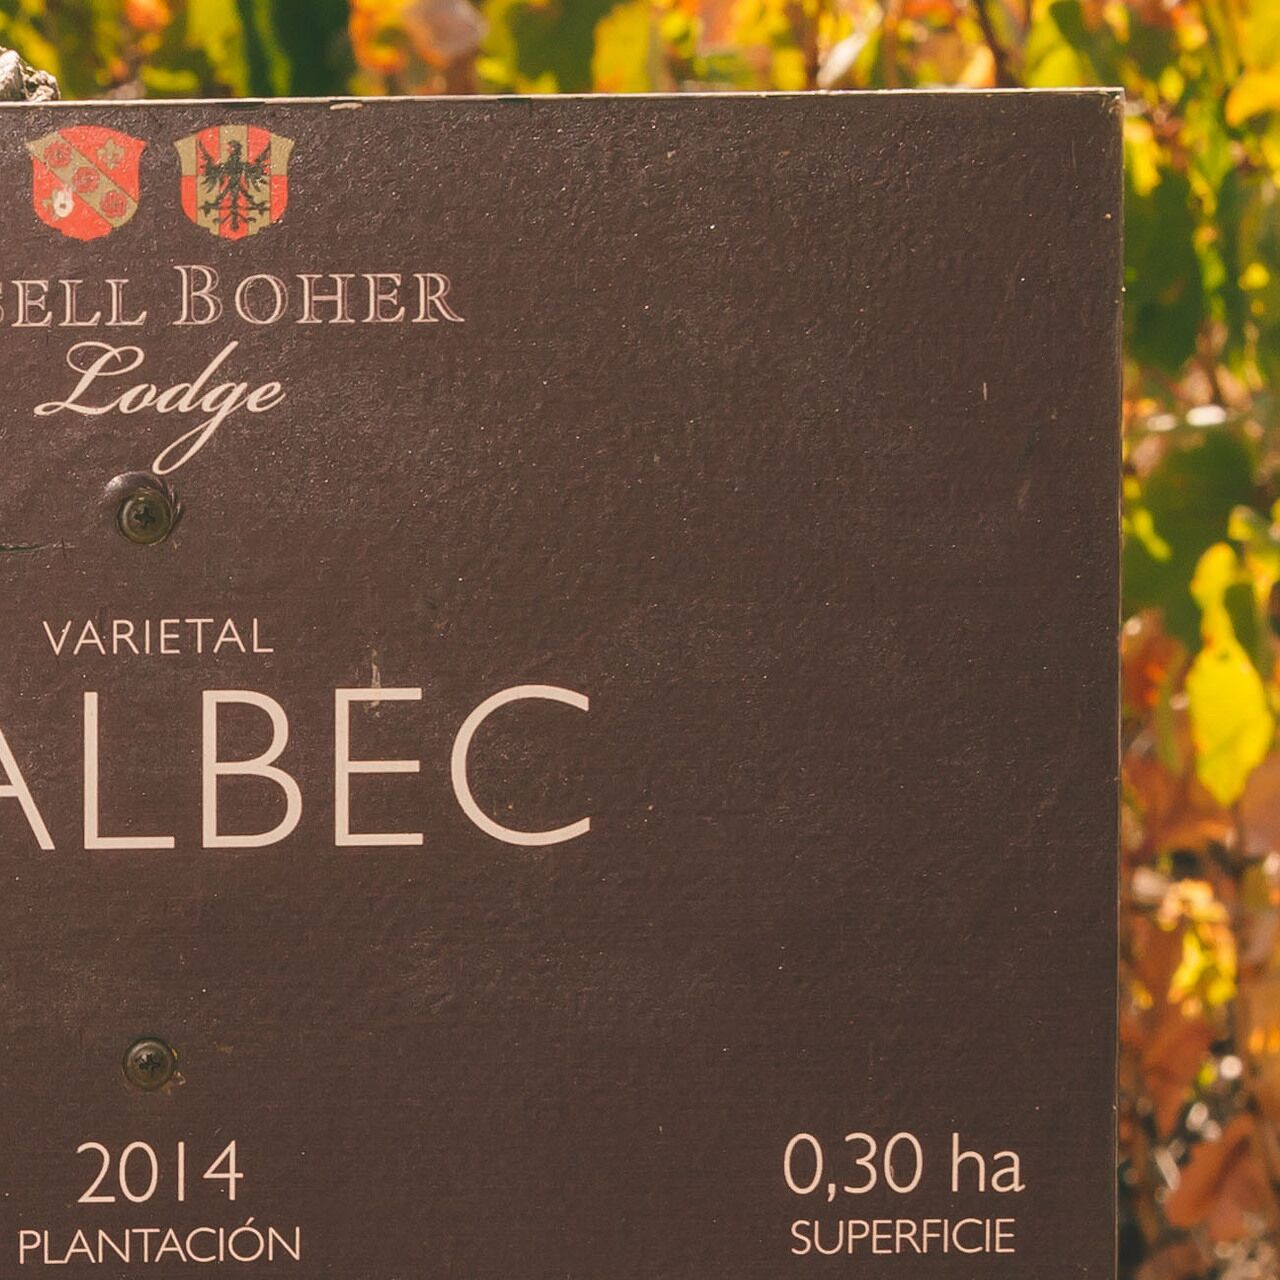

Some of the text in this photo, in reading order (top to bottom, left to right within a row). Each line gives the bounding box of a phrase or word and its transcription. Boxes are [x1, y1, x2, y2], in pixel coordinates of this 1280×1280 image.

[171, 263, 466, 327] BOHER
[32, 339, 288, 476] Lodge
[41, 616, 275, 657] VARIETAL
[76, 1139, 245, 1204] 2014
[782, 1131, 1027, 1203] 0,30 ha
[18, 1217, 301, 1266] PLANTACIÓN
[790, 1217, 1016, 1256] SUPERFICIE
